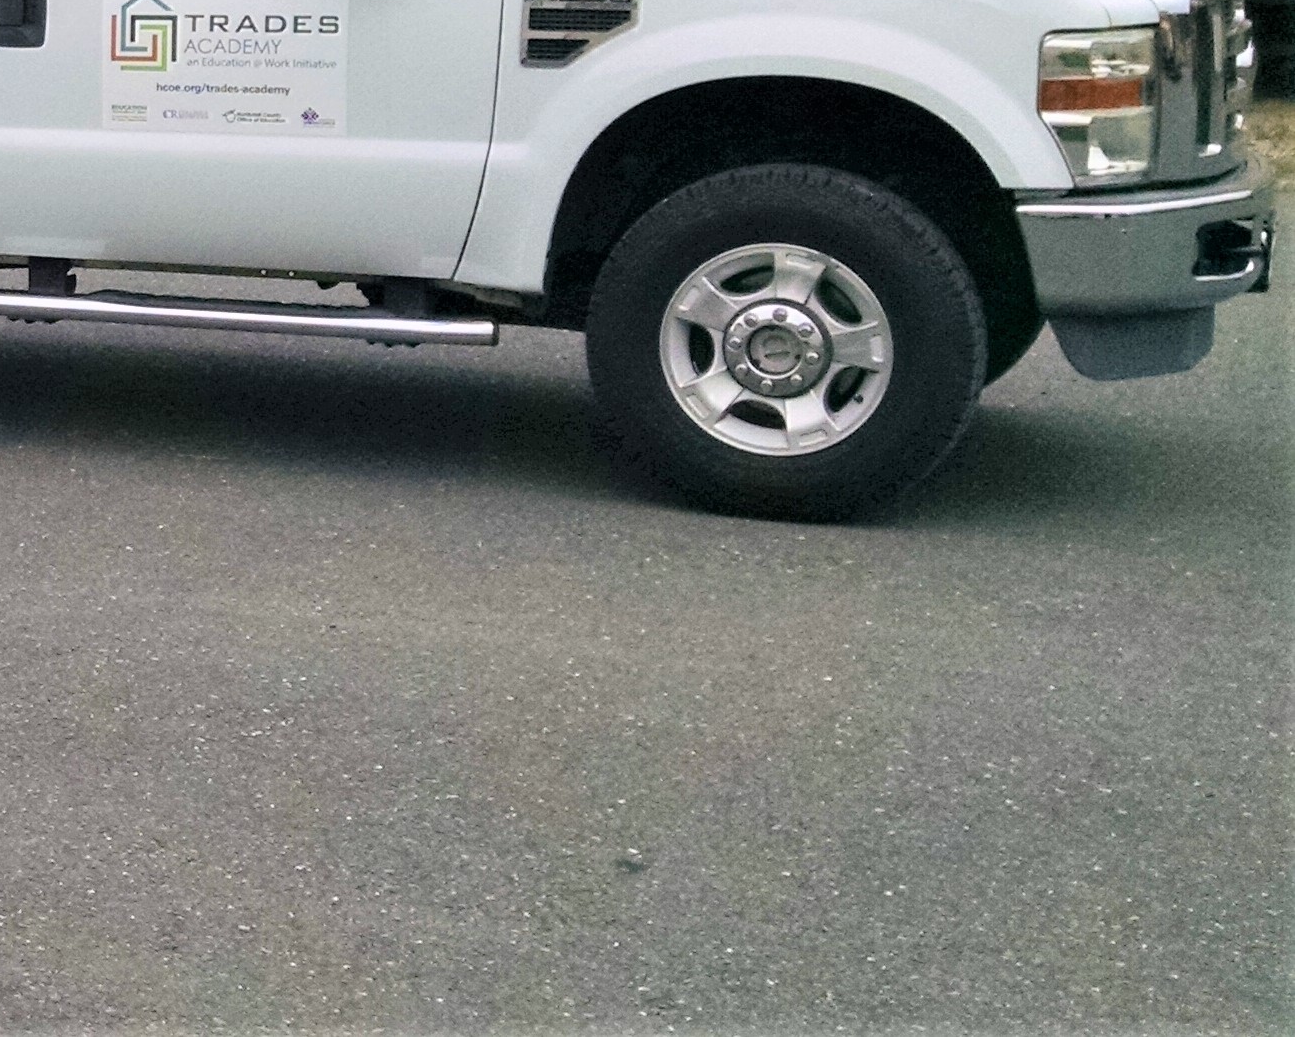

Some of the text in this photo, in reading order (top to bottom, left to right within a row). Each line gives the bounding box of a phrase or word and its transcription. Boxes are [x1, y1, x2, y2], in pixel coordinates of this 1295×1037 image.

[184, 14, 339, 34] TRADES
[184, 38, 282, 55] ACADEMY
[186, 60, 200, 68] an
[202, 57, 251, 68] Education
[264, 58, 289, 68] Work
[293, 58, 337, 69] Initiative
[156, 83, 291, 96] hcoe.org/trades-academy
